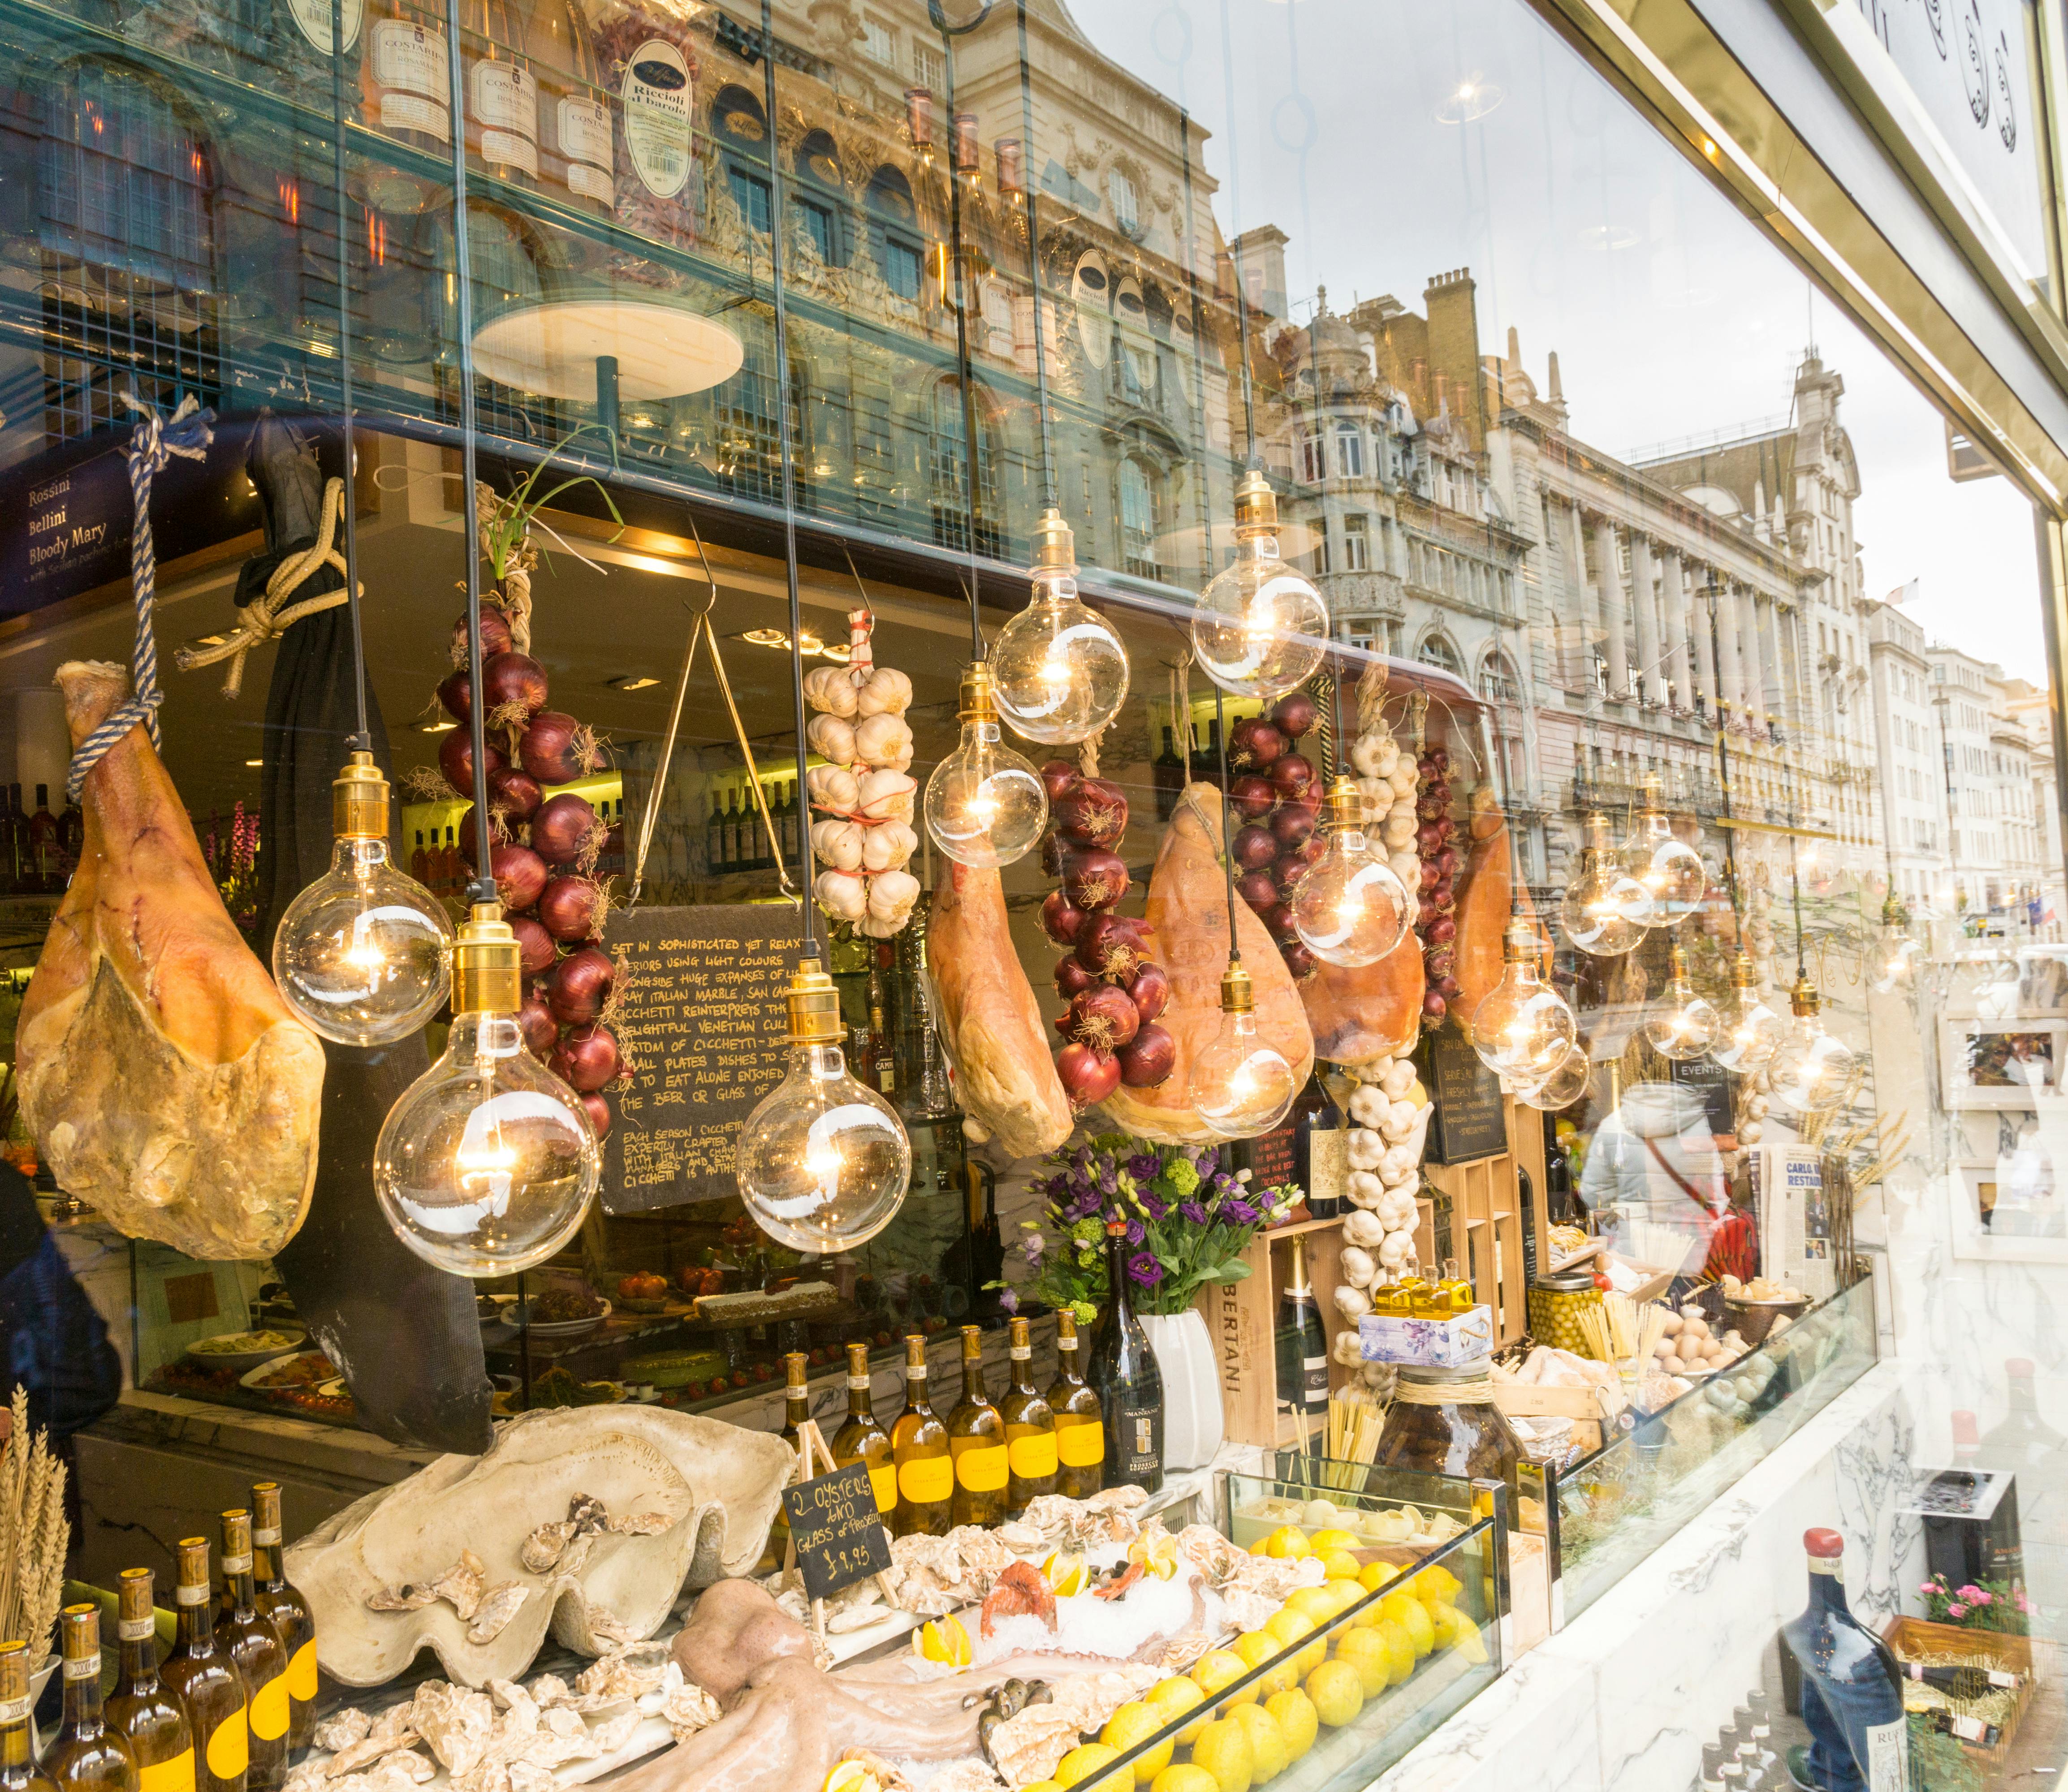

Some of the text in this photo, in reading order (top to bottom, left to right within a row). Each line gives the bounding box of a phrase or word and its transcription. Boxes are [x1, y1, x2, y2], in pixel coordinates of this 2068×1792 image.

[385, 40, 445, 64] COSTARIPA
[397, 56, 438, 73] ROSAMARA
[635, 86, 684, 105] Riccioli
[647, 97, 685, 116] barolo
[1079, 287, 1105, 302] Riccioli
[1121, 311, 1146, 325] Riccioli
[28, 474, 70, 508] Rossini
[29, 505, 66, 536] Bellini
[30, 536, 68, 566] Bloody
[72, 522, 107, 548] Mary
[610, 943, 634, 955] SET
[639, 940, 649, 952] IN
[658, 938, 739, 951] SOPHISTICATED
[745, 939, 763, 954] YET
[667, 955, 699, 968] USING
[706, 956, 734, 967] LIGHT
[740, 955, 784, 967] COLOURS
[680, 973, 709, 986] HUGE
[716, 969, 765, 985] EXPANSES
[770, 969, 784, 980] OF
[623, 989, 644, 1004] RAY
[651, 988, 688, 1004] ITALIAN
[696, 987, 738, 1002] MARBLE
[747, 985, 768, 999] SAN
[682, 1004, 760, 1020] REINTERPRETS
[698, 1019, 755, 1034] VENETIAN
[671, 1039, 686, 1052] OF
[664, 1055, 707, 1072] PLATES
[717, 1053, 757, 1066] DISHES
[761, 1053, 777, 1063] TO
[1681, 1064, 1723, 1075] EVENTS
[640, 1074, 656, 1088] TO
[665, 1073, 691, 1088] EAT
[695, 1069, 731, 1085] ALONE
[738, 1068, 784, 1082] ENJOYED
[619, 1084, 769, 1116] THE BEER OR GLASS OF
[1446, 1086, 1471, 1098] FRESHLY
[623, 1131, 649, 1144] EACH
[654, 1125, 692, 1140] SEASON
[624, 1136, 728, 1156] EXPERTLY CRAFTED
[623, 1154, 652, 1167] WITH
[660, 1148, 701, 1163] ITALIAN
[624, 1161, 681, 1175] MANAGERS
[688, 1157, 708, 1169] AND
[1272, 1163, 1282, 1172] OUR
[1283, 1161, 1295, 1171] BEST
[686, 1168, 697, 1179] IS
[1261, 1173, 1290, 1187] COCKTAILS
[1223, 1283, 1241, 1392] BERTANI
[1130, 1460, 1158, 1468] PROSECCO
[1130, 1464, 1158, 1472] SUPERIORE
[792, 1474, 871, 1516] 2 OYSTERS
[826, 1501, 855, 1524] AND
[797, 1527, 834, 1553] GLASS
